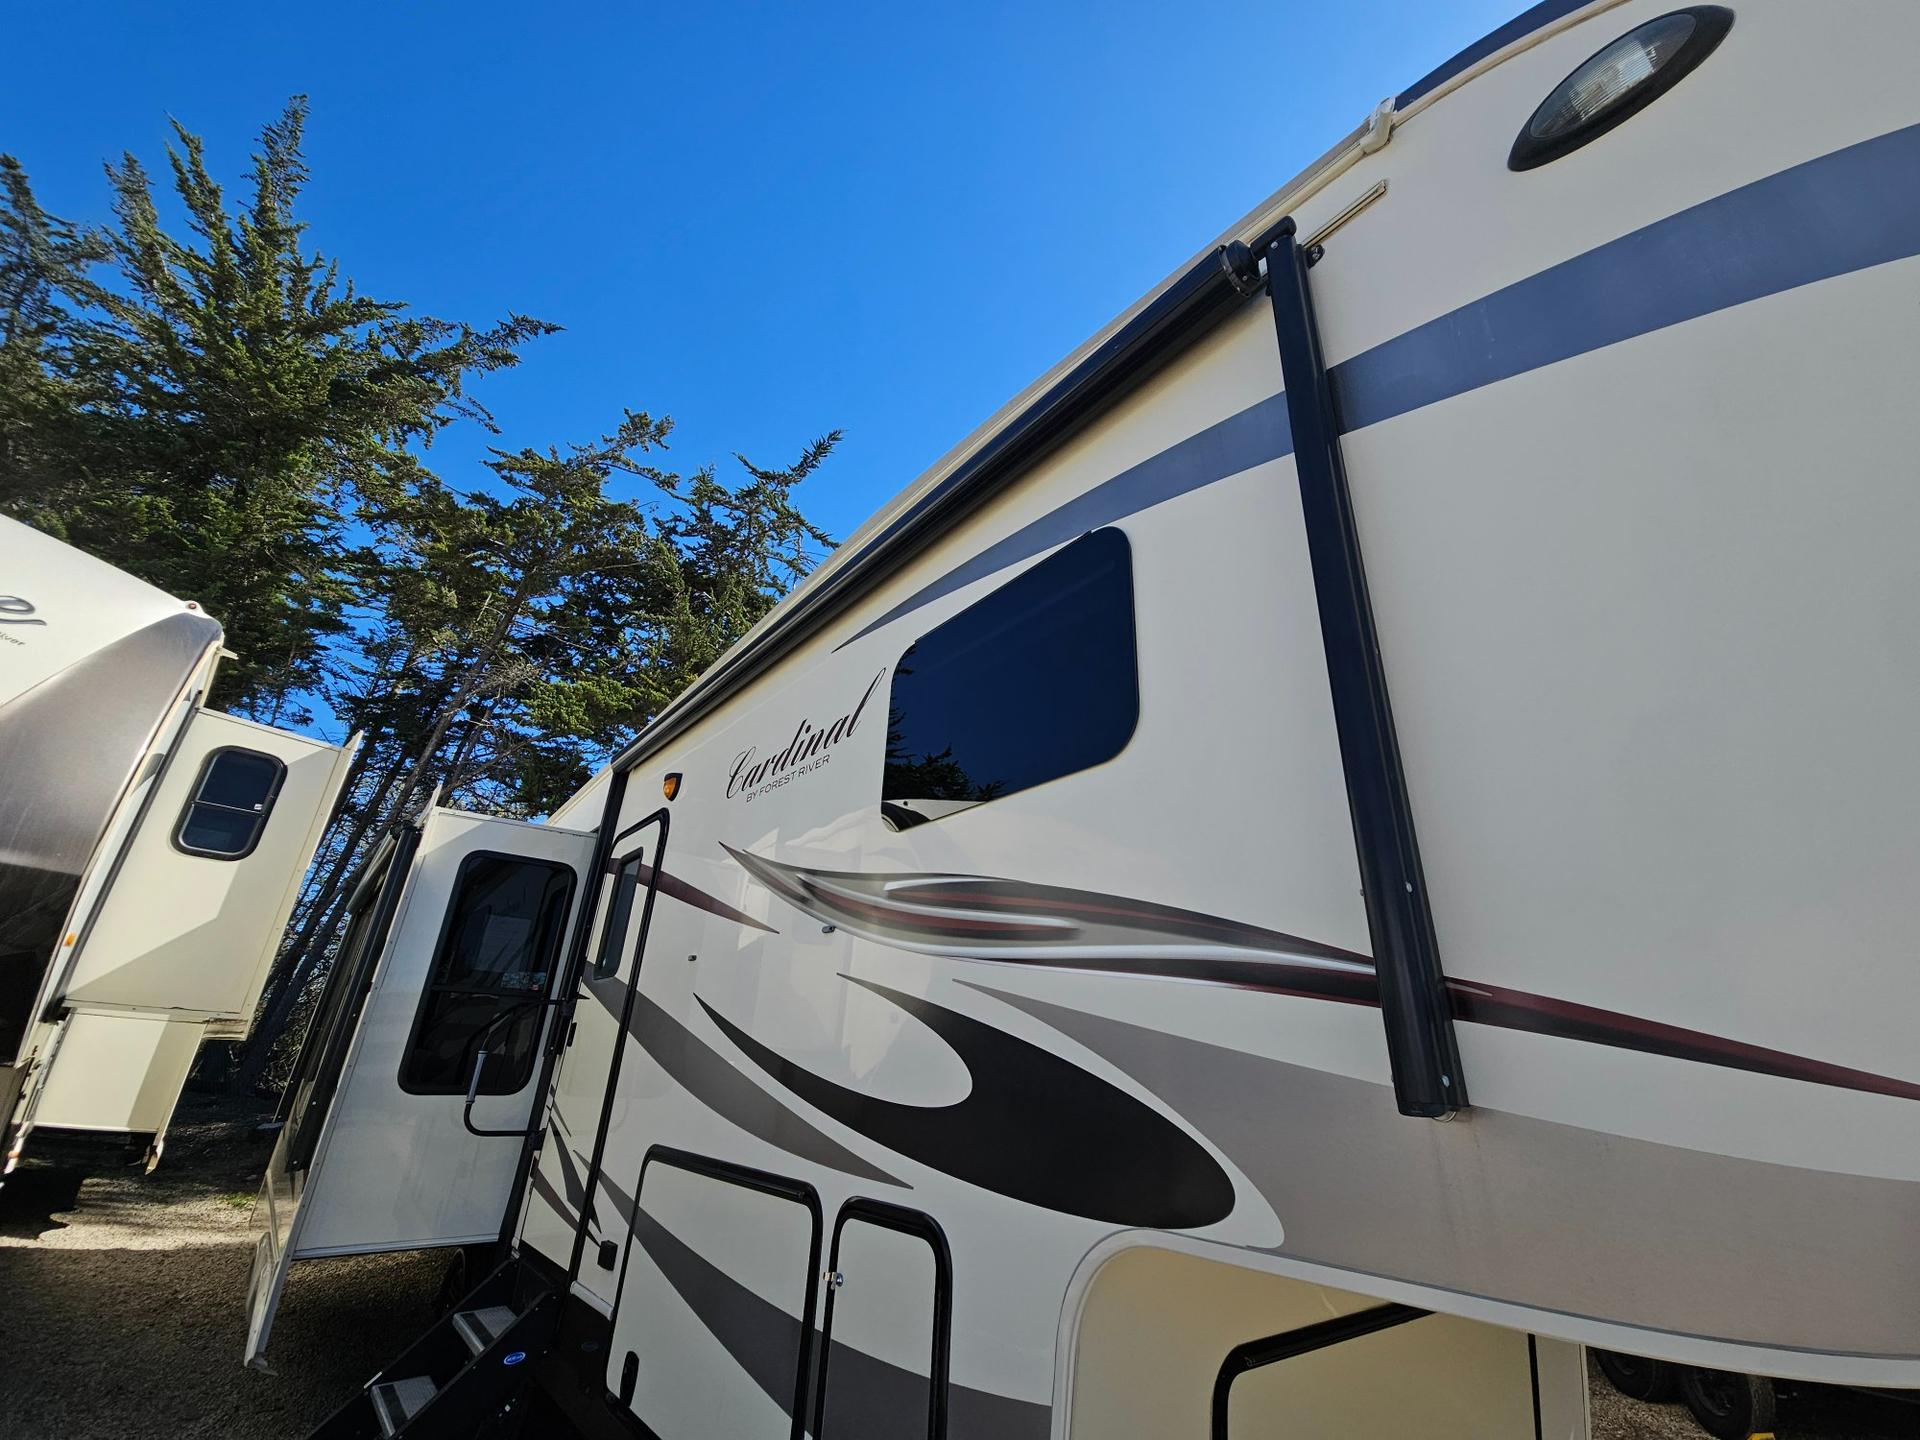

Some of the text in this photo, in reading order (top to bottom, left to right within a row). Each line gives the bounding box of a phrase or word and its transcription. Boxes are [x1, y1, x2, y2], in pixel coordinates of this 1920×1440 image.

[726, 667, 887, 799] Cardinal
[746, 754, 831, 803] BY FOREST RIVER
